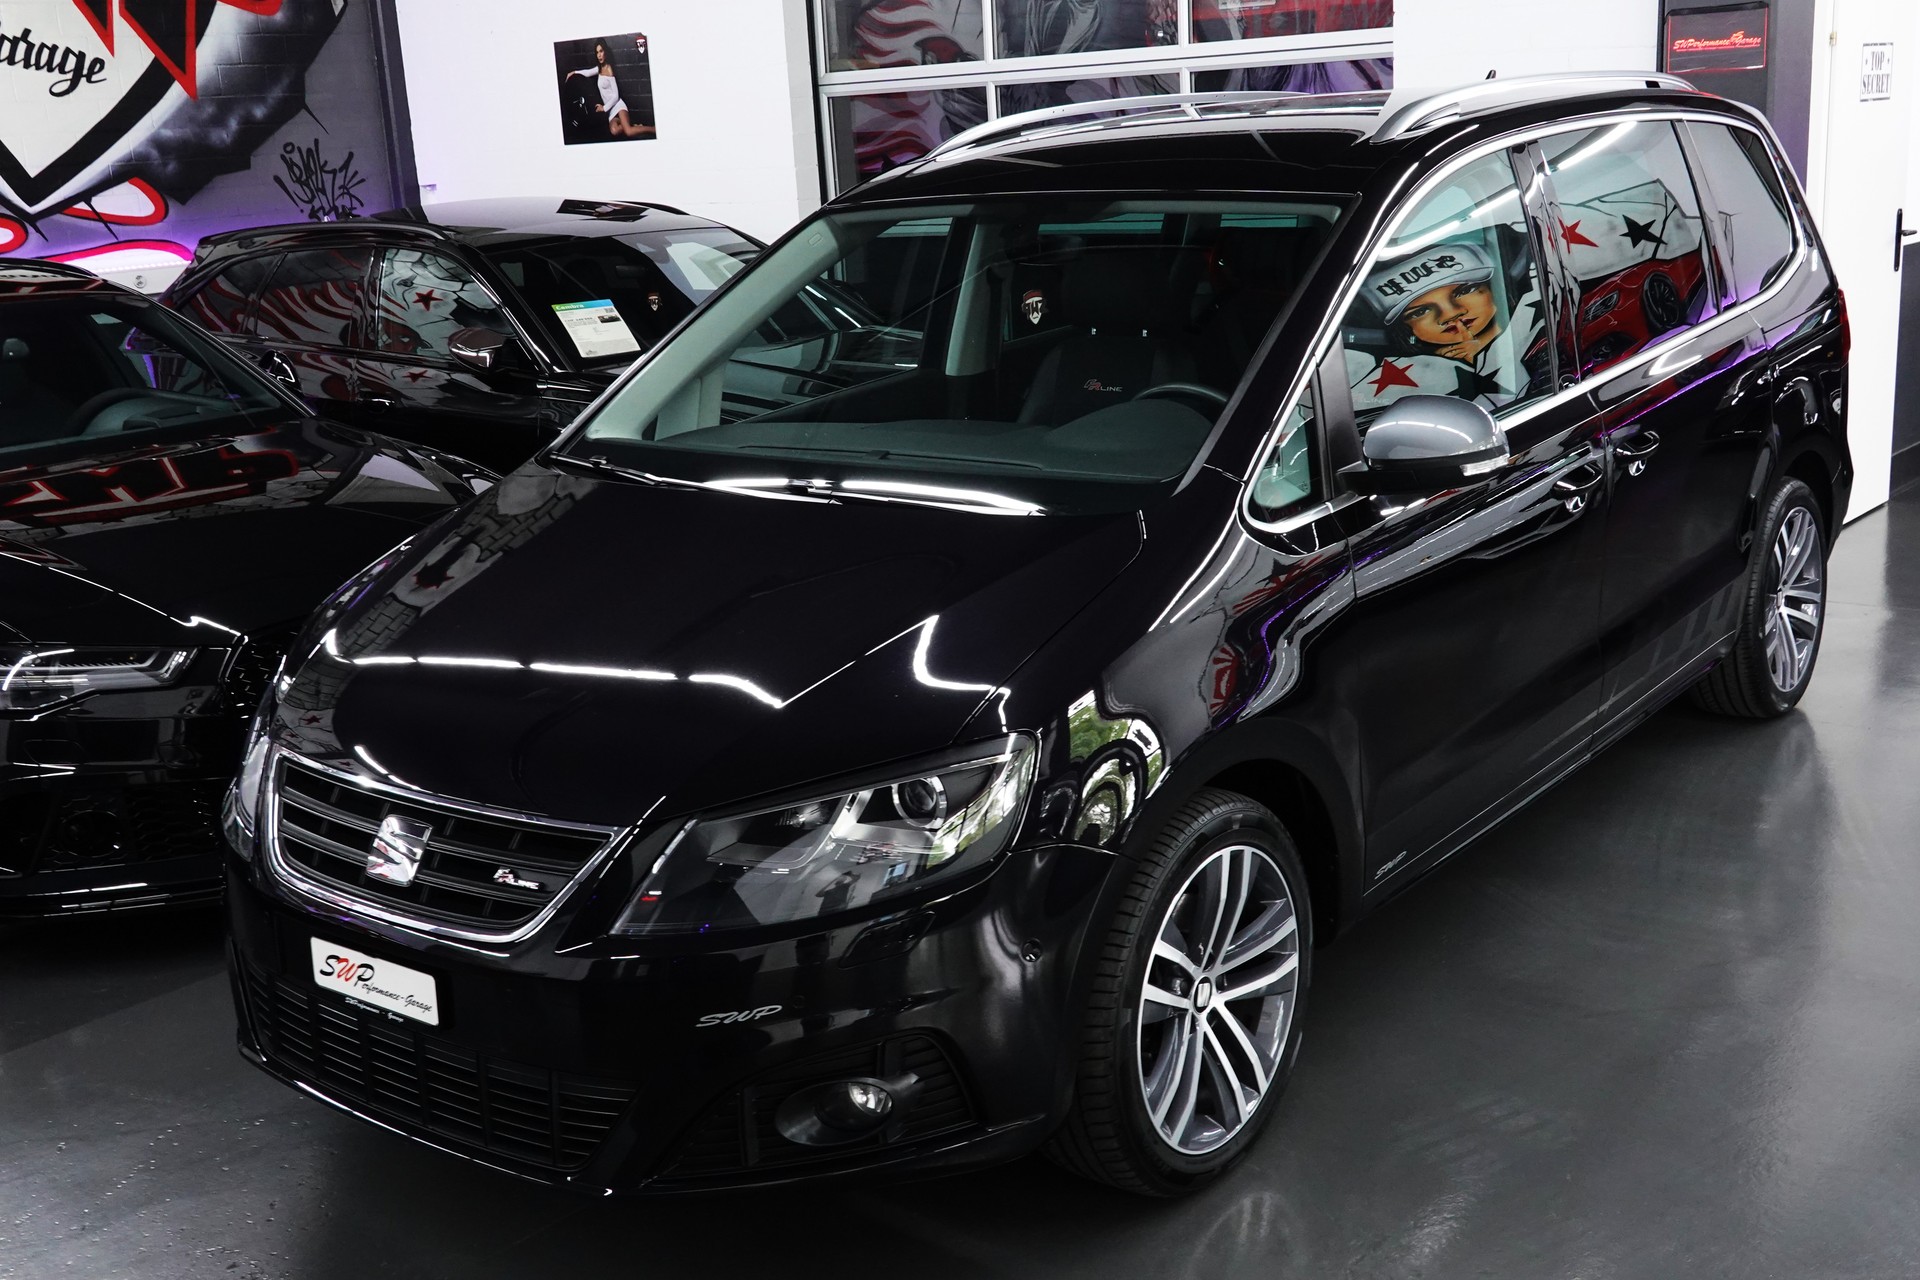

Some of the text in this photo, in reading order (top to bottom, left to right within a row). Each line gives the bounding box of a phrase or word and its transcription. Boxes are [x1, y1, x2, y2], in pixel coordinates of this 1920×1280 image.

[0, 28, 107, 97] arage
[1871, 51, 1885, 71] TOP
[1861, 74, 1891, 95] SECRET
[695, 1005, 783, 1028] SWP
